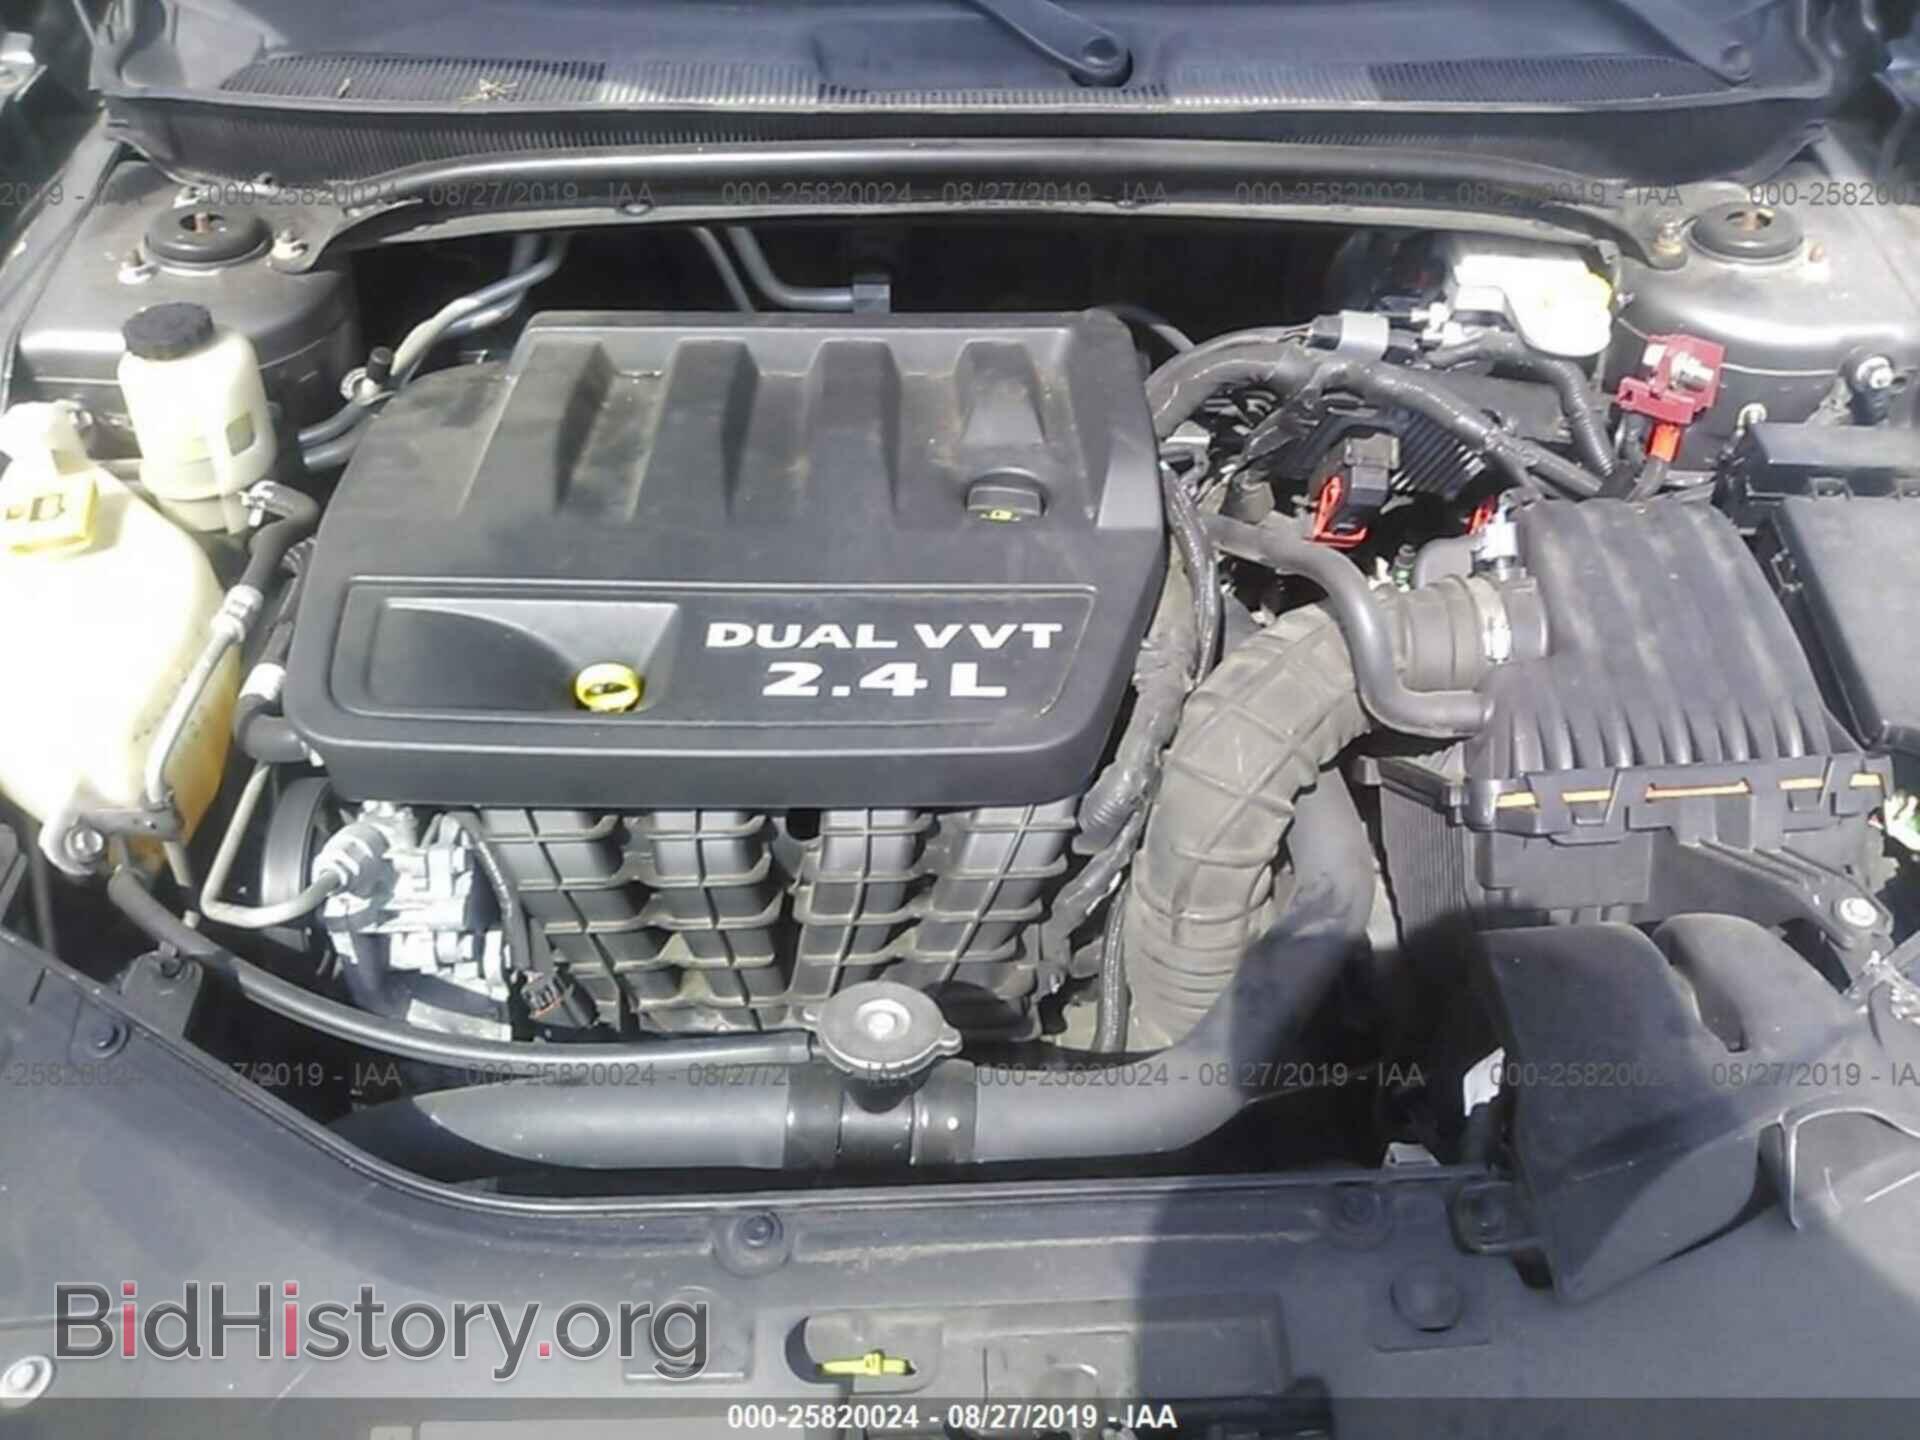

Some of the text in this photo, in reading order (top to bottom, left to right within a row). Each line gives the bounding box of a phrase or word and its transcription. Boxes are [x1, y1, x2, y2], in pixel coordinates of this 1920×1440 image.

[705, 622, 1063, 649] DUAL VVT
[762, 661, 1008, 698] 2.4 L
